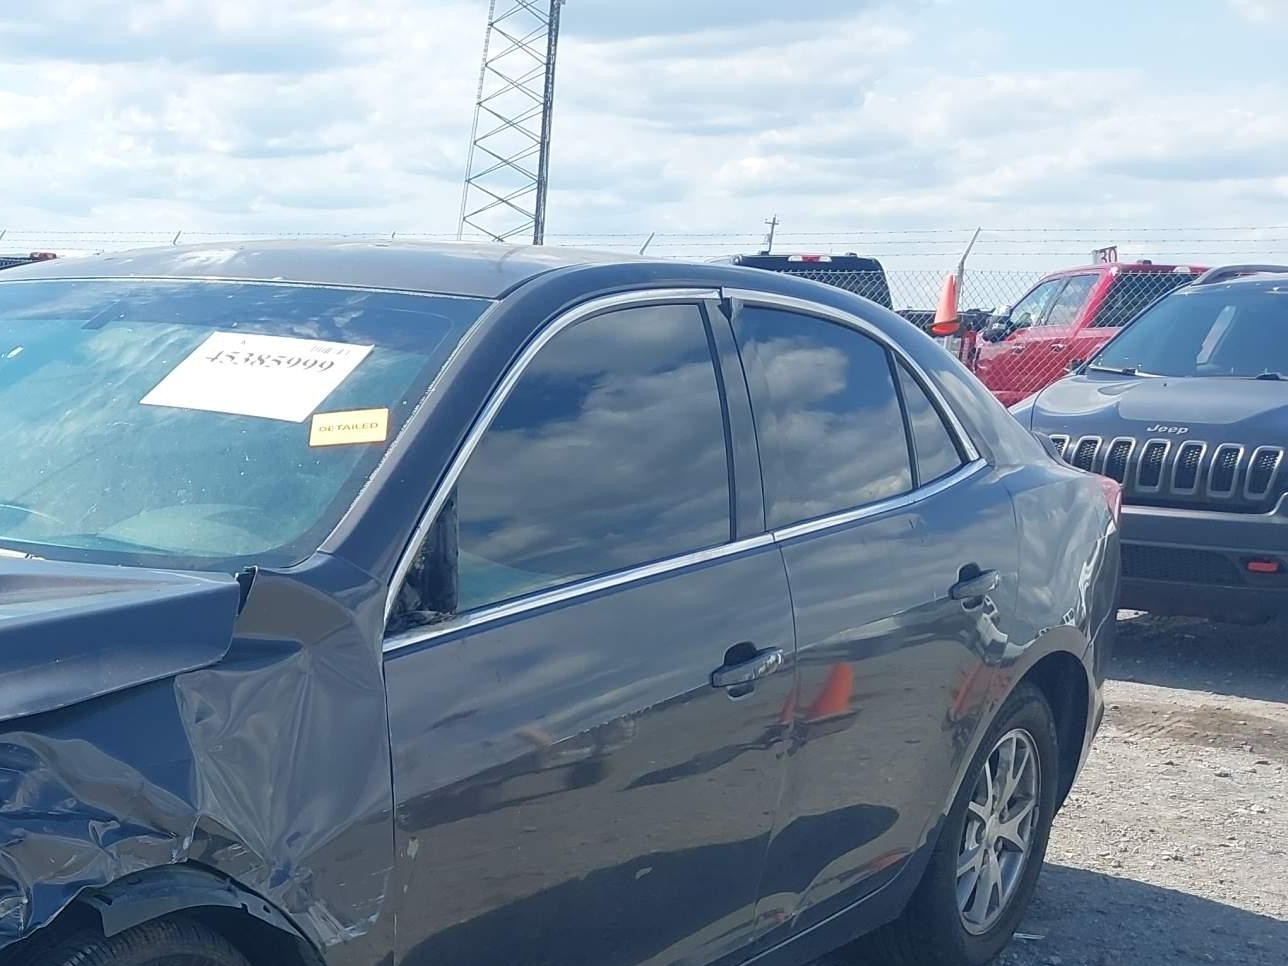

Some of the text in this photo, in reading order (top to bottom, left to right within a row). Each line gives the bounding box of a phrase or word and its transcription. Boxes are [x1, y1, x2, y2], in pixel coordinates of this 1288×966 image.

[205, 350, 335, 372] 45385999
[317, 421, 379, 433] DETAILED
[1146, 424, 1189, 435] Jeep
